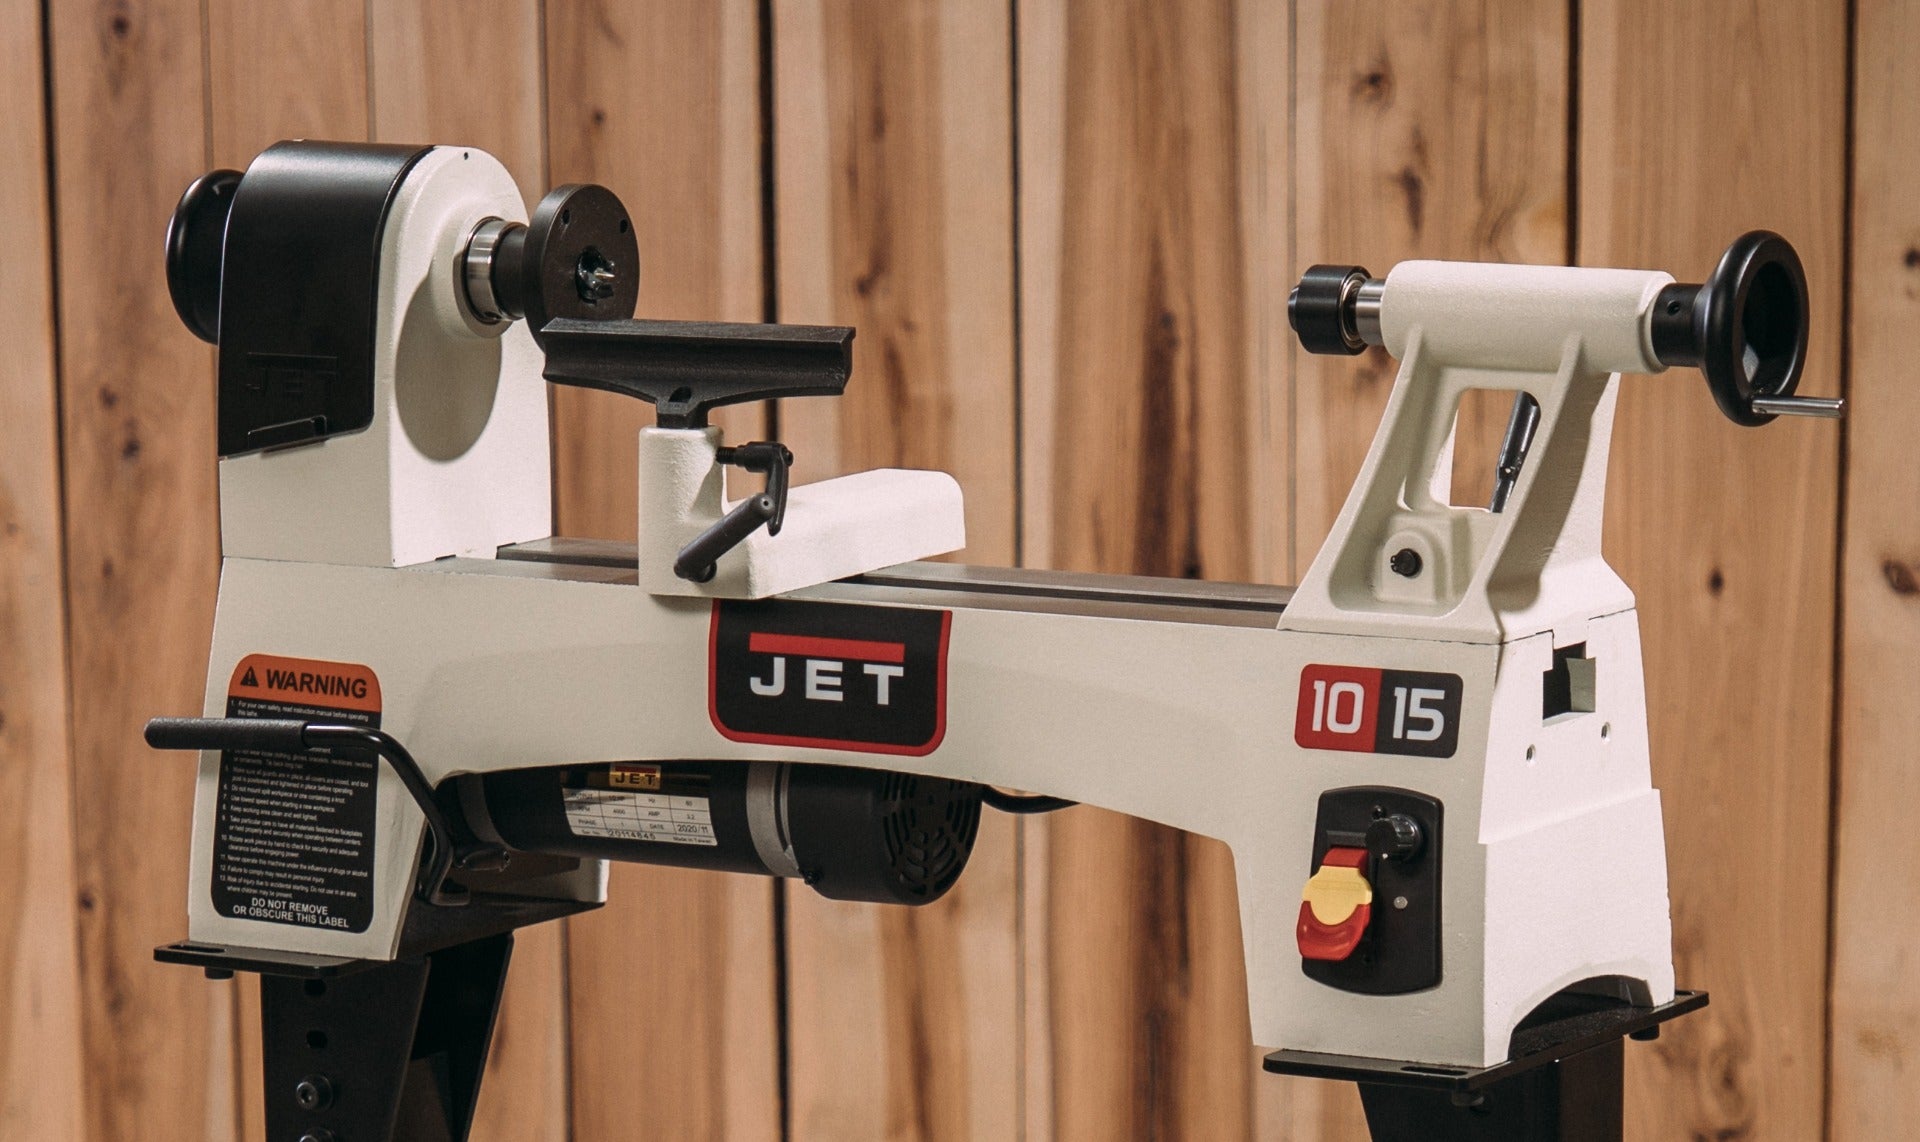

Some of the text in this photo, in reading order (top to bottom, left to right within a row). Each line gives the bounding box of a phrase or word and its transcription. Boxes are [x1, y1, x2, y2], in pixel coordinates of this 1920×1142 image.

[246, 367, 337, 396] JET
[266, 668, 367, 698] WARNING
[750, 656, 904, 706] JET
[1312, 680, 1446, 741] 10 15
[615, 773, 656, 785] JET
[233, 905, 349, 928] OR OBSCURE THIS LABEL
[252, 897, 328, 915] DO NOT REMOVE
